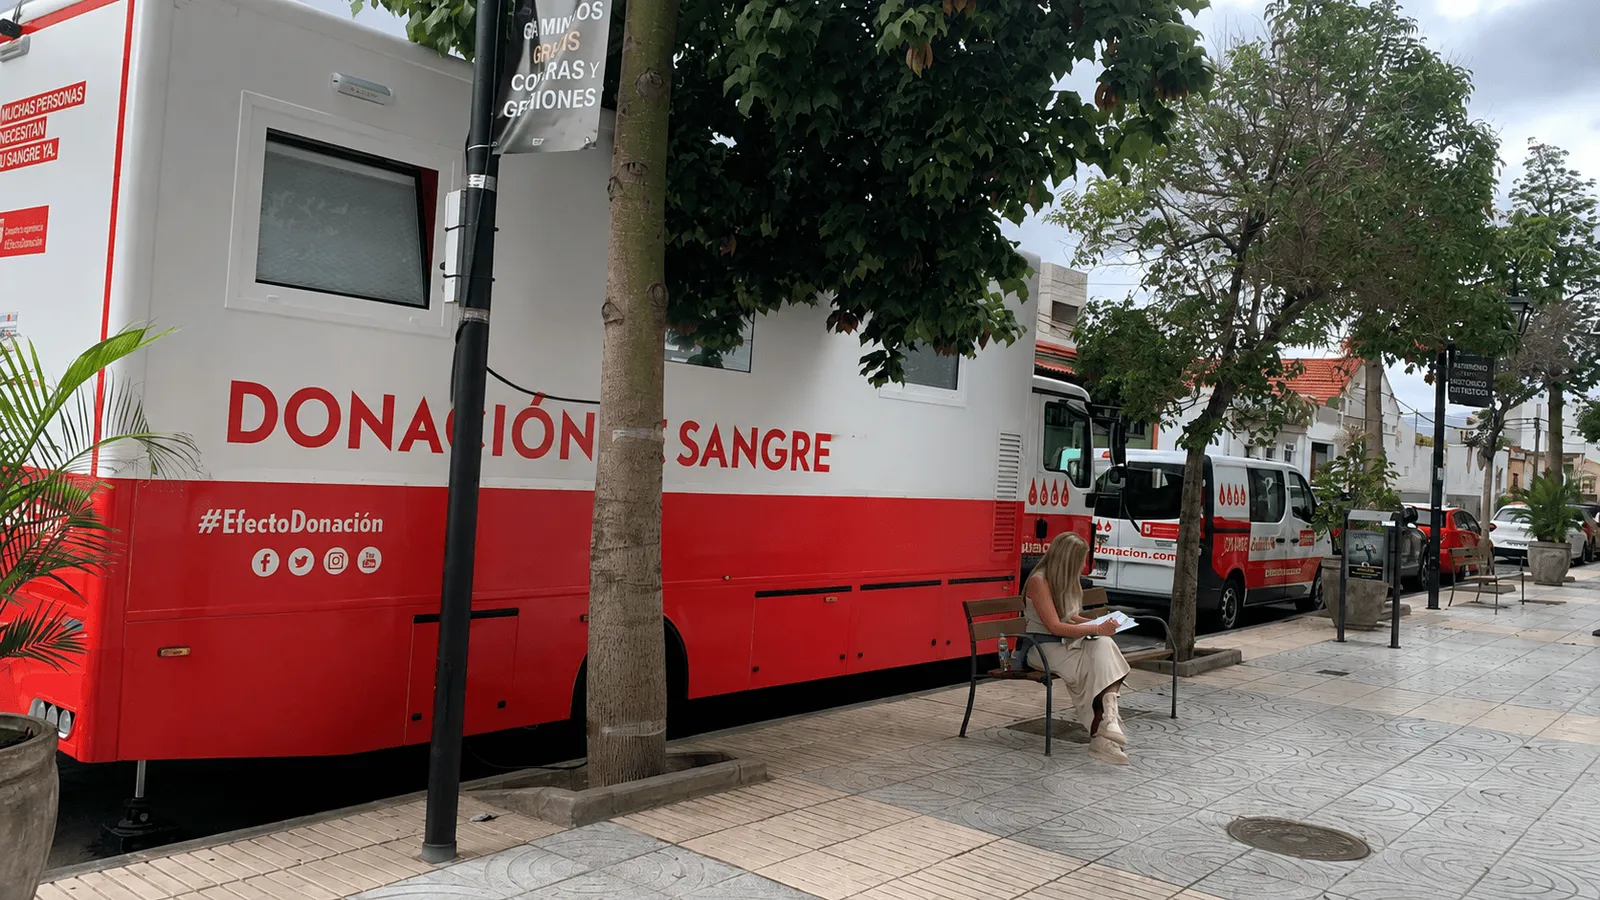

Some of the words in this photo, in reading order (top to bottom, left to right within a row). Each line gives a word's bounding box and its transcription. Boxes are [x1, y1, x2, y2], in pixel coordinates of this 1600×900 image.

[590, 61, 600, 79] Y
[2, 100, 35, 121] MUCHAS
[36, 86, 83, 113] PERSONAS
[0, 120, 45, 144] NECESITAN
[6, 145, 41, 167] SANGRE
[42, 142, 56, 159] YA.
[676, 420, 832, 473] SANGRE
[198, 508, 384, 534] #EfectoDonación
